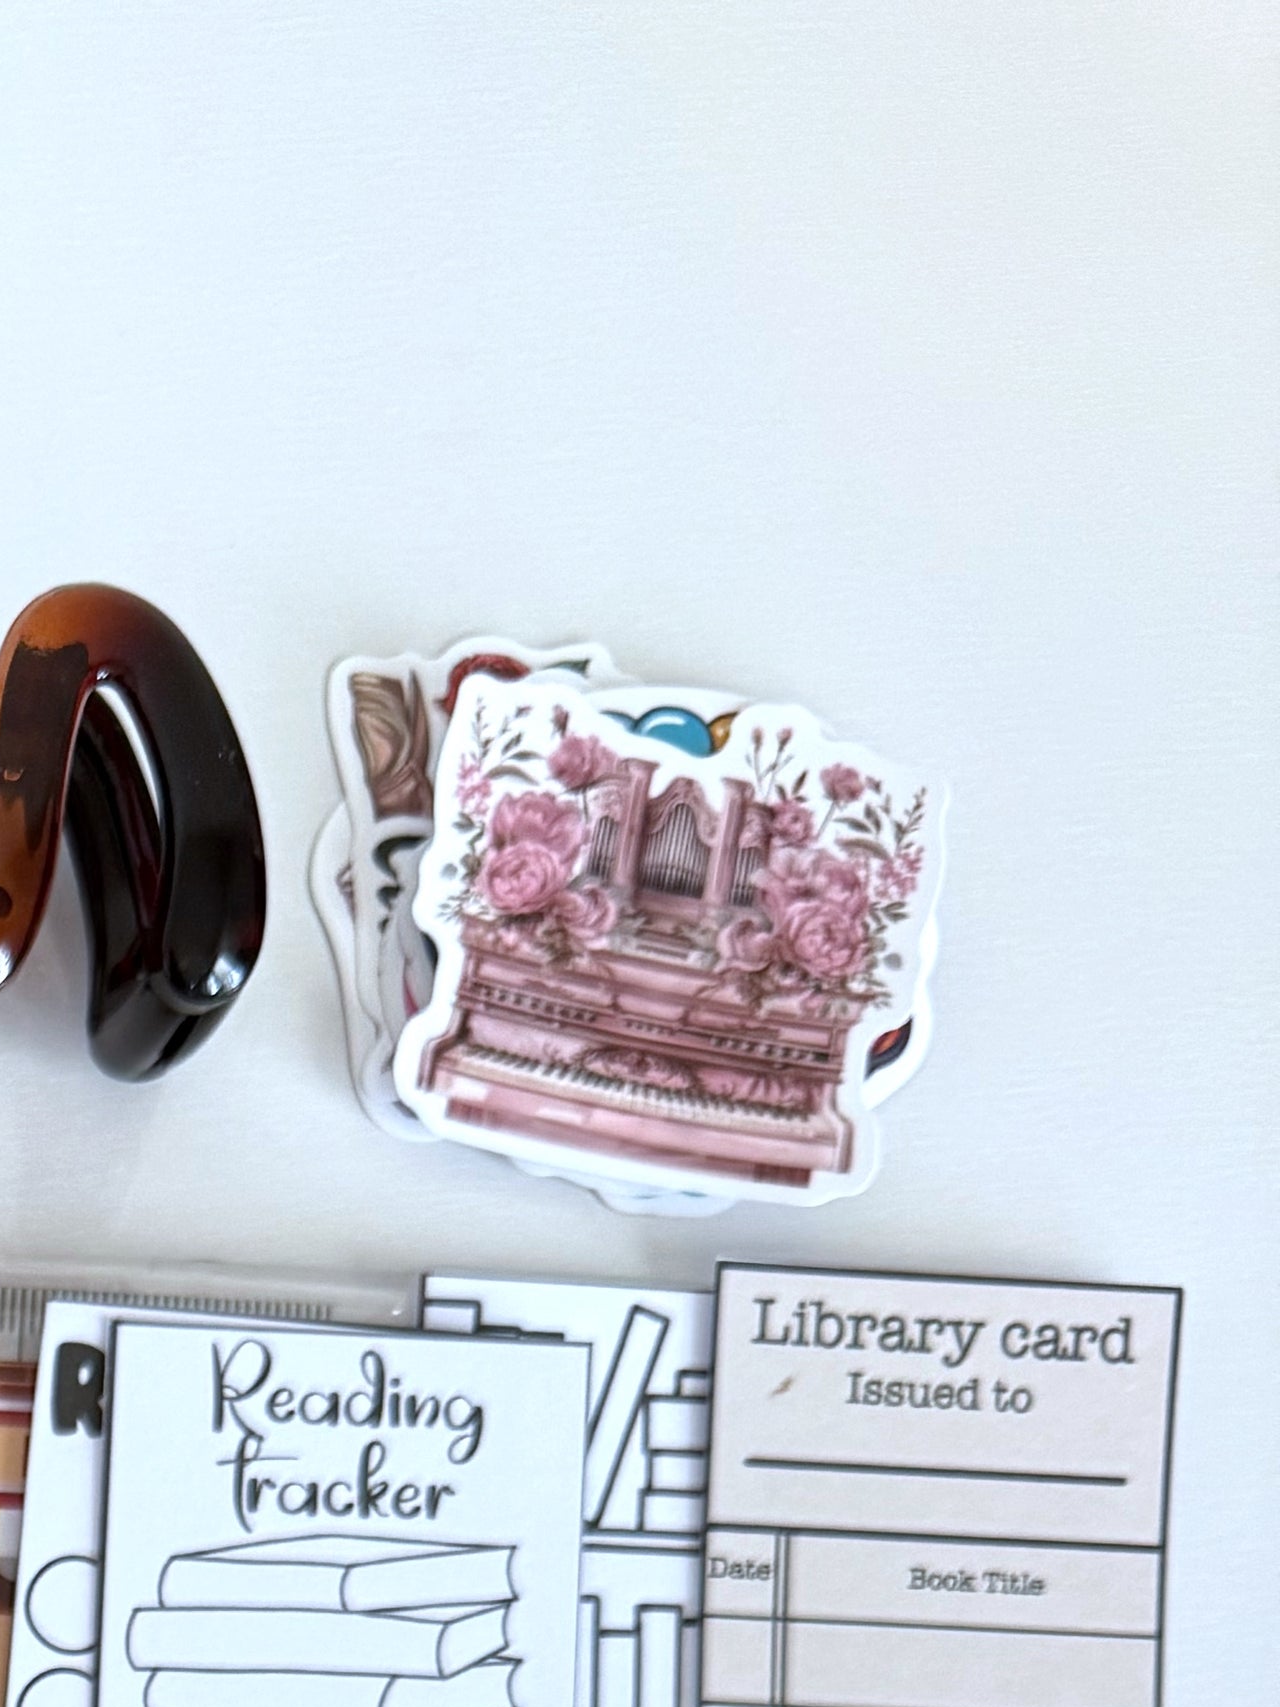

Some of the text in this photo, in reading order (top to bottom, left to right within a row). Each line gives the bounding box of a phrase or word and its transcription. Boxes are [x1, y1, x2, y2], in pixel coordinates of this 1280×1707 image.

[751, 1298, 1137, 1368] Library card
[211, 1339, 484, 1464] Reading
[845, 1371, 1035, 1414] Issued to
[707, 1556, 773, 1582] Date
[907, 1567, 1048, 1597] Book Title
